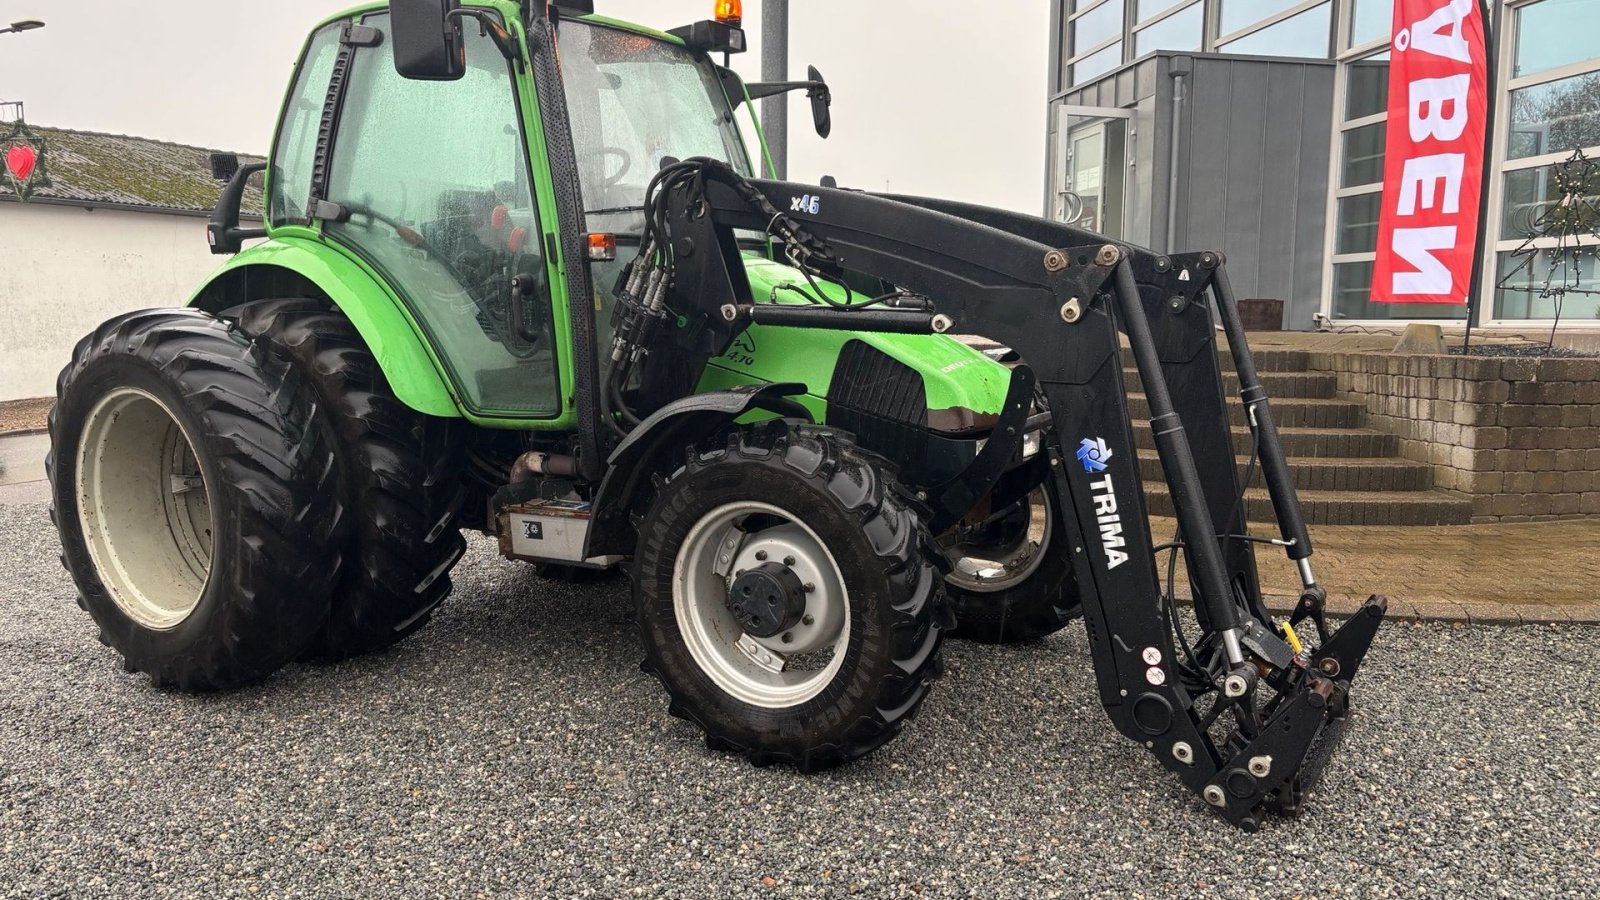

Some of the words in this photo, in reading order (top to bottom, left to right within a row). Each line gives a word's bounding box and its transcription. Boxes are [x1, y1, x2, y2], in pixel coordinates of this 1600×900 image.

[790, 194, 820, 215] x46
[641, 484, 696, 599] ALLIANCE
[1090, 473, 1129, 570] TRIMA
